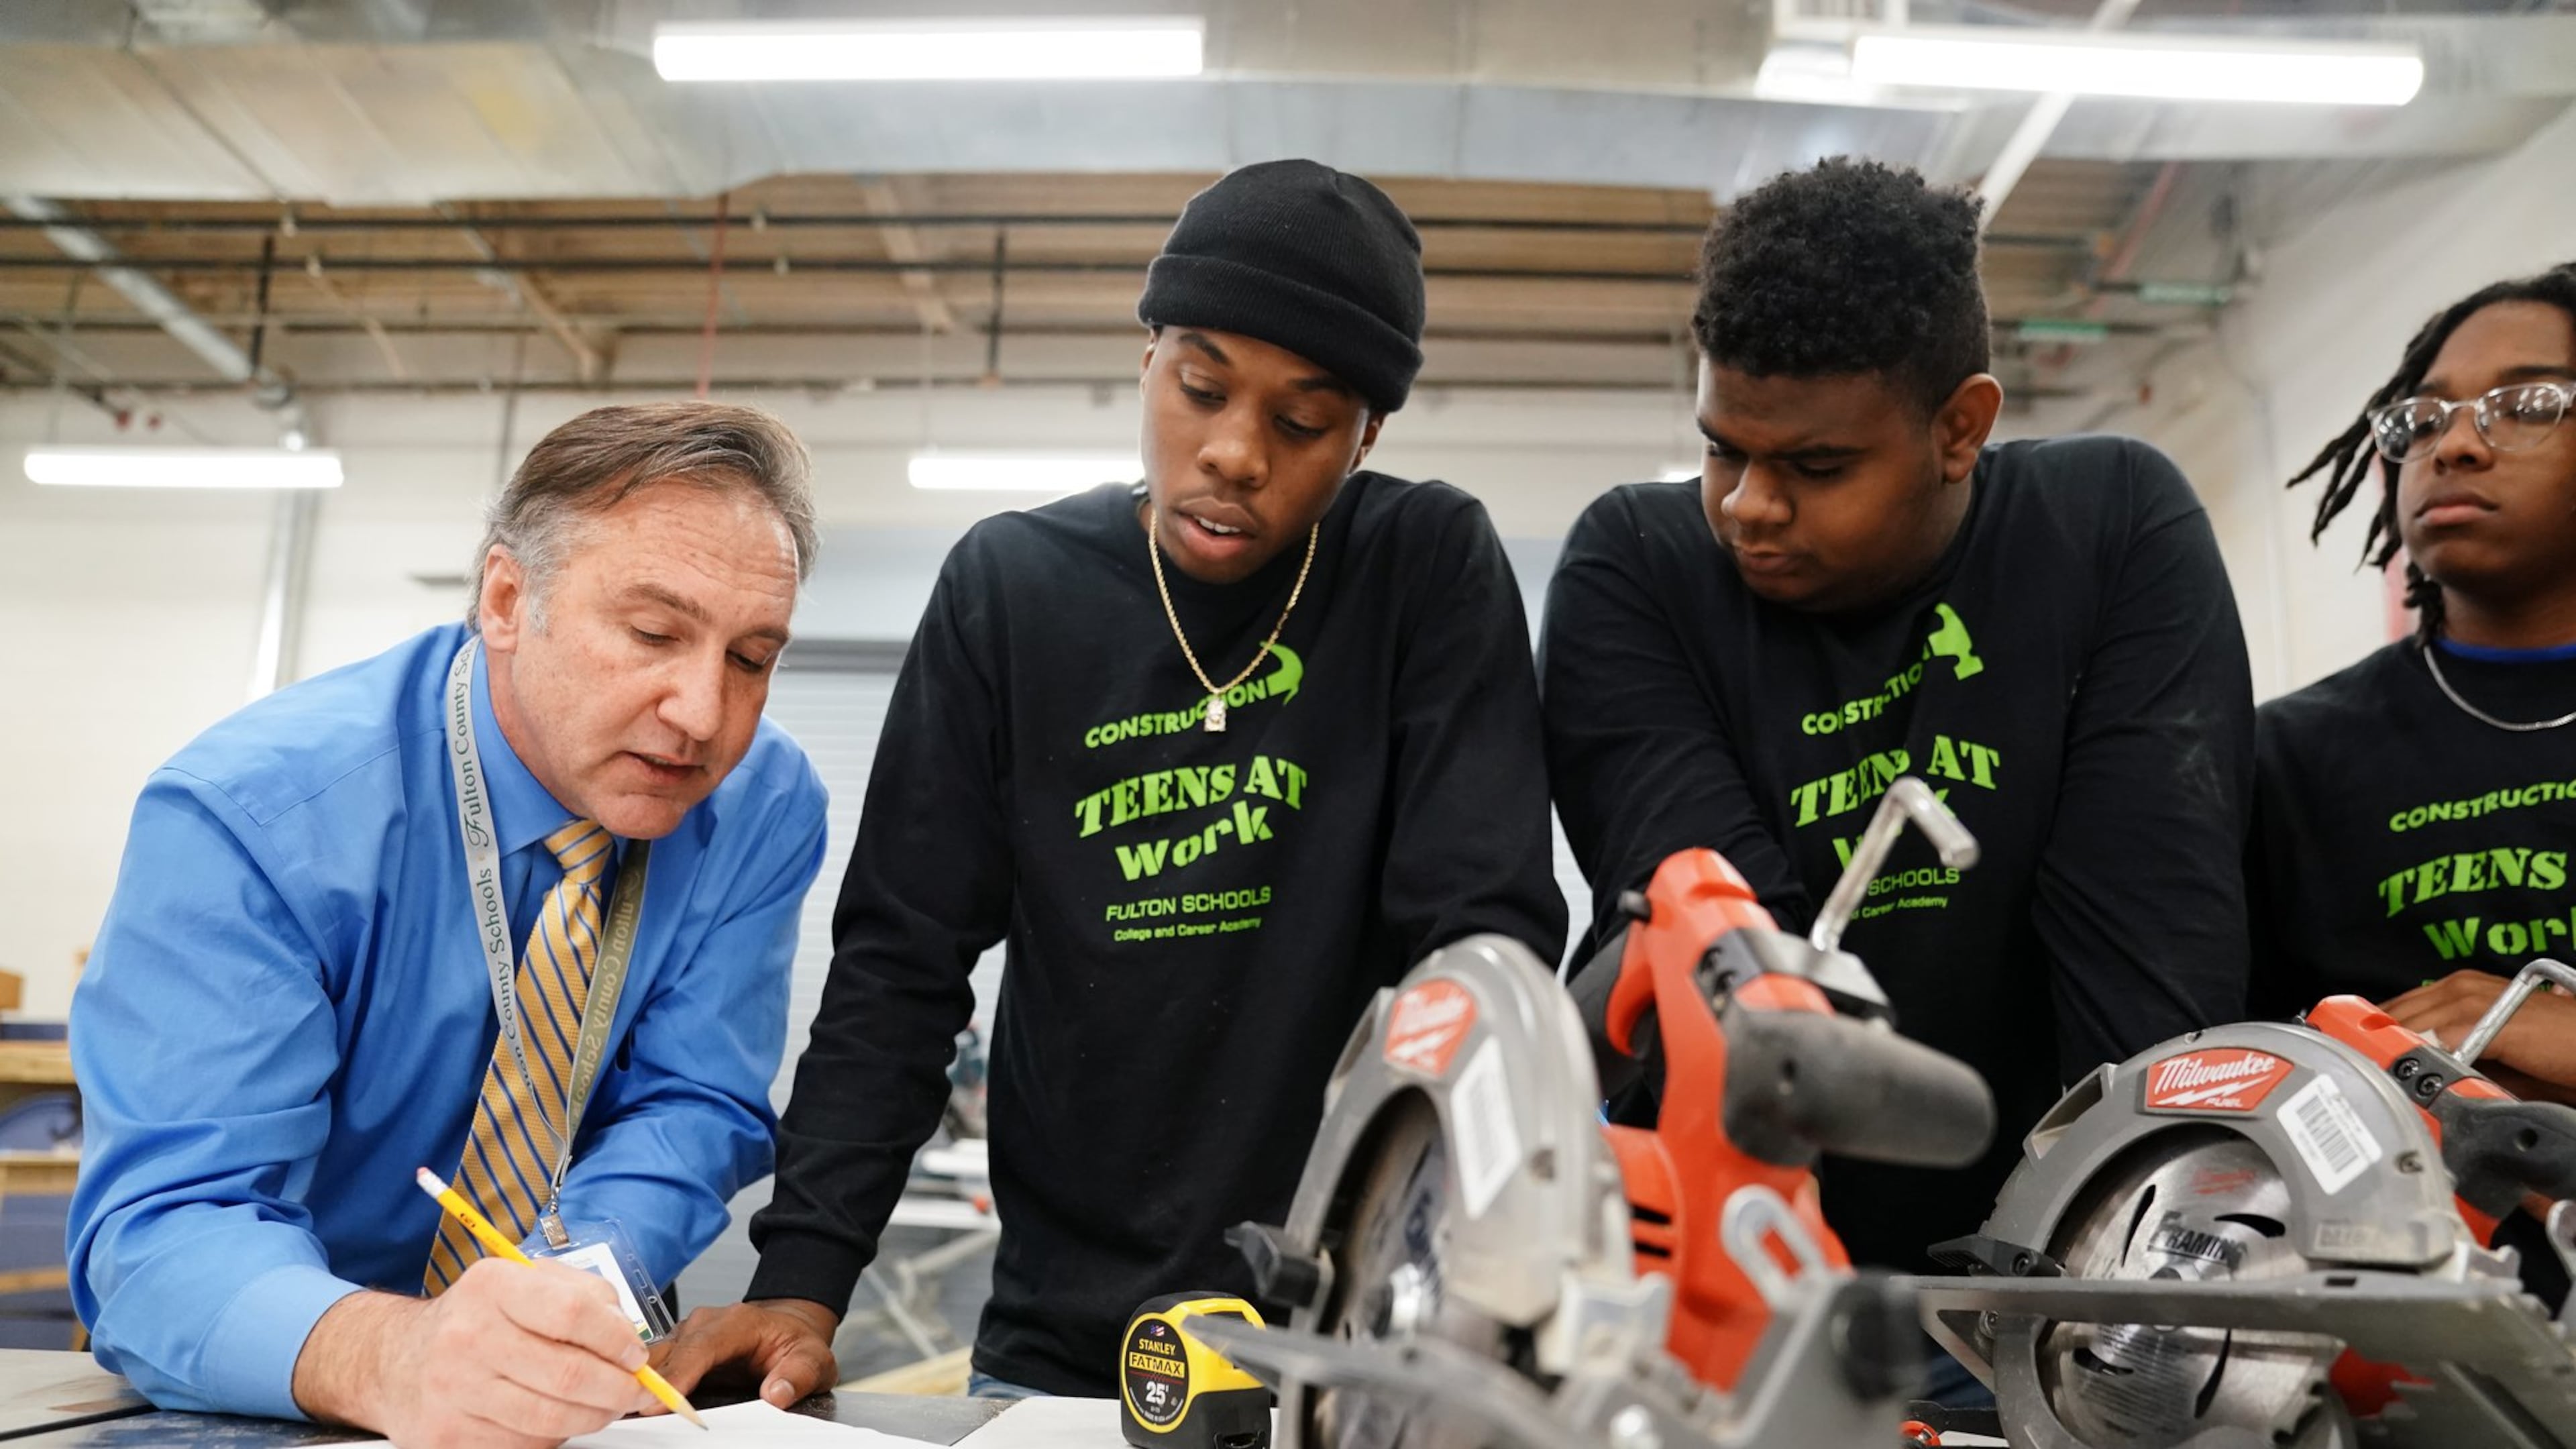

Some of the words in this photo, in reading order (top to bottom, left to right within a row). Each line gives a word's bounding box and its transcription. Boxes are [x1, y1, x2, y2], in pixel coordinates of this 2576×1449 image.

[454, 682, 470, 755] County
[1925, 735, 2000, 790] AT
[462, 761, 489, 847] Fulton
[1075, 763, 1237, 838] TEENS
[1243, 755, 1307, 810] AT
[1115, 800, 1274, 881] Work
[1106, 897, 1177, 922] FULTON
[1181, 885, 1272, 913] SCHOOLS
[1868, 867, 1960, 897] SCHOOLS
[1897, 896, 1949, 909] Academy
[2377, 847, 2568, 918] TEENS
[476, 867, 505, 954] Schools
[1114, 928, 1152, 941] College
[1154, 925, 1175, 938] and
[1177, 923, 1217, 936] Career
[1219, 917, 1262, 932] Academy
[498, 961, 516, 1040] County
[2153, 1051, 2276, 1095] Milwaukee
[1131, 1354, 1181, 1376] FATMAX
[1138, 1338, 1176, 1356] STANLEY
